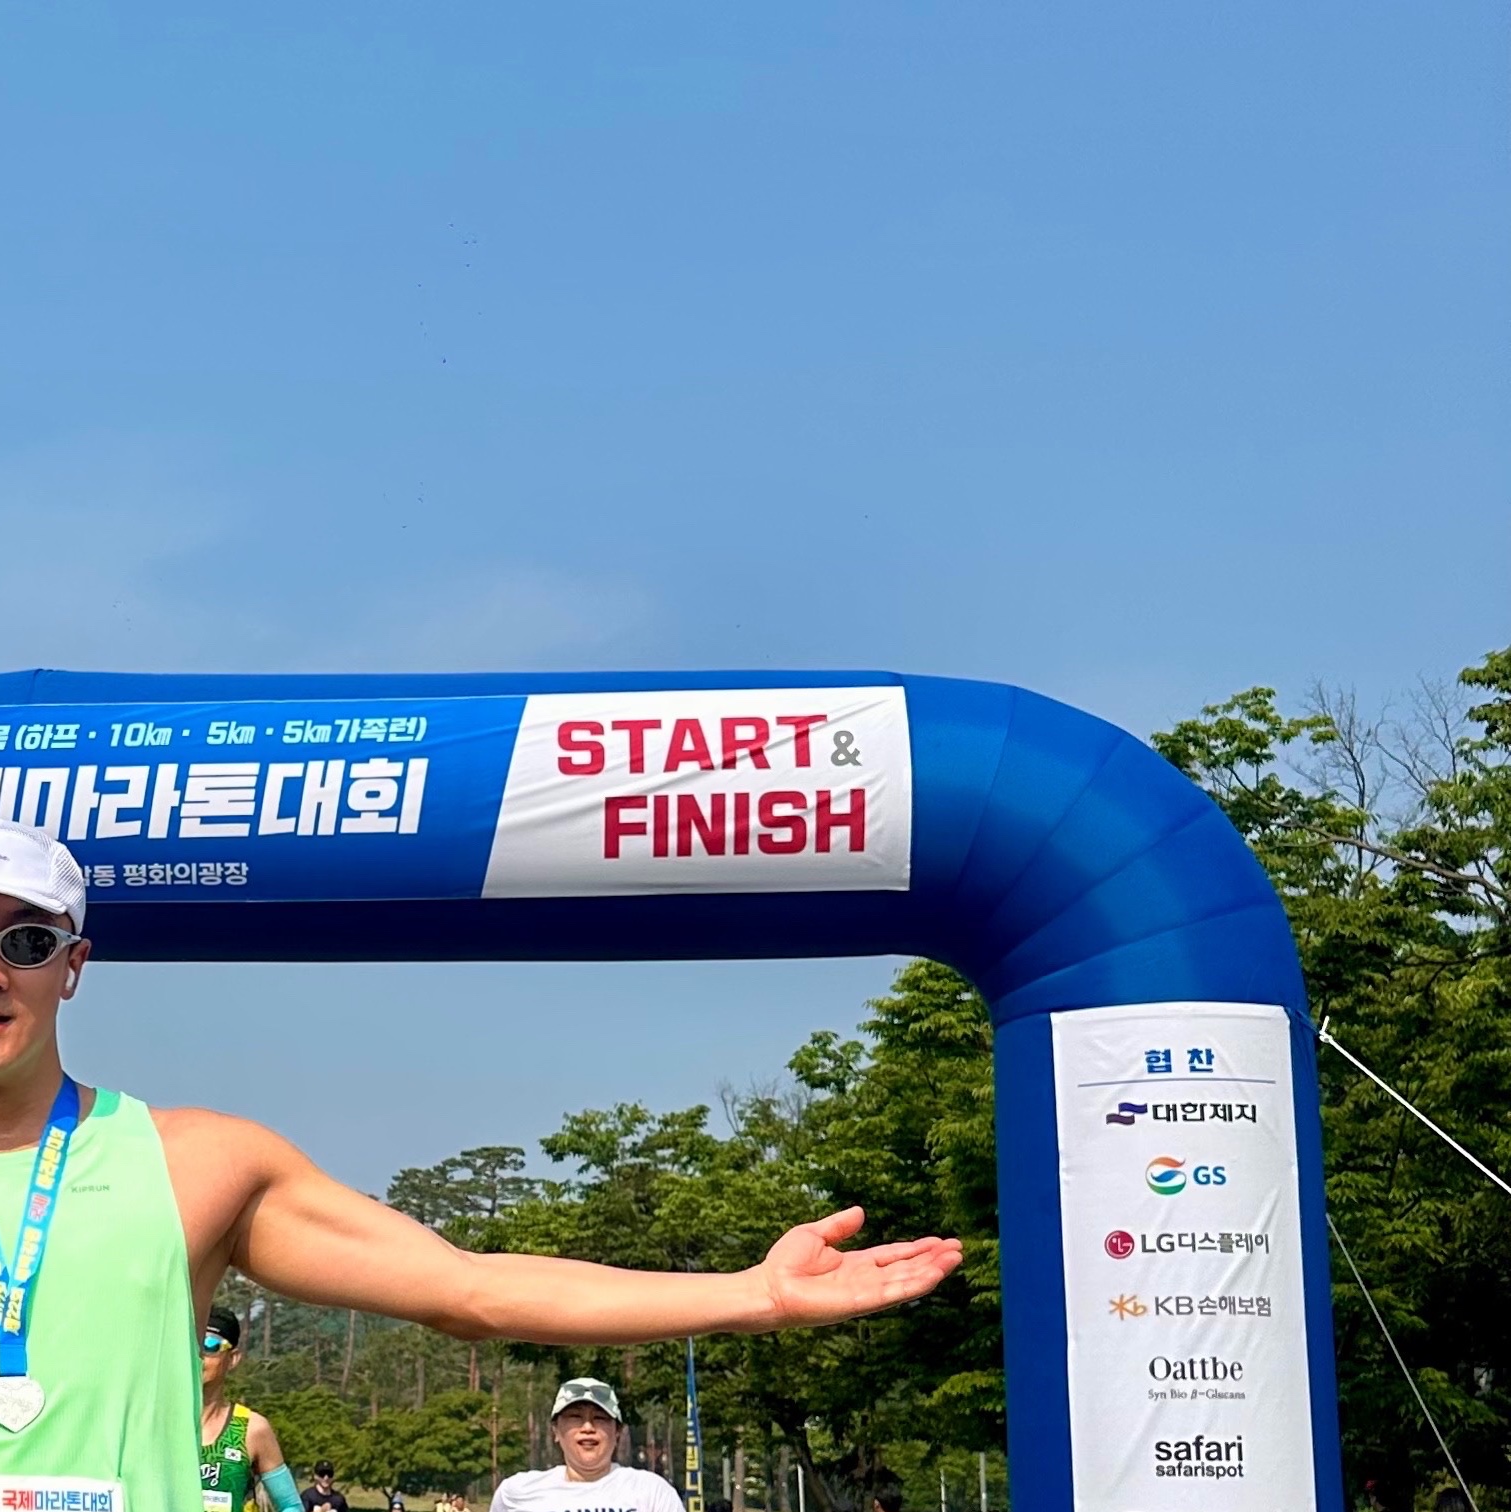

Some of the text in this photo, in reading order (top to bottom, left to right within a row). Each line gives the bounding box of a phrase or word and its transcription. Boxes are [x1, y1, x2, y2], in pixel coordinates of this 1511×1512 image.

[557, 714, 864, 776] START &
[604, 787, 867, 859] FINISH
[122, 862, 250, 886] 평화의광장
[1151, 1101, 1257, 1123] 대한제지
[1192, 1165, 1228, 1186] GS
[1140, 1231, 1270, 1255] LG디스플레이
[1148, 1355, 1244, 1382] Oattbe
[1147, 1388, 1167, 1402] Syn
[1169, 1388, 1188, 1400] Bio
[1154, 1435, 1244, 1462] safari
[1155, 1462, 1245, 1480] safarispot
[2, 1488, 114, 1512] 국제마라톤대회
